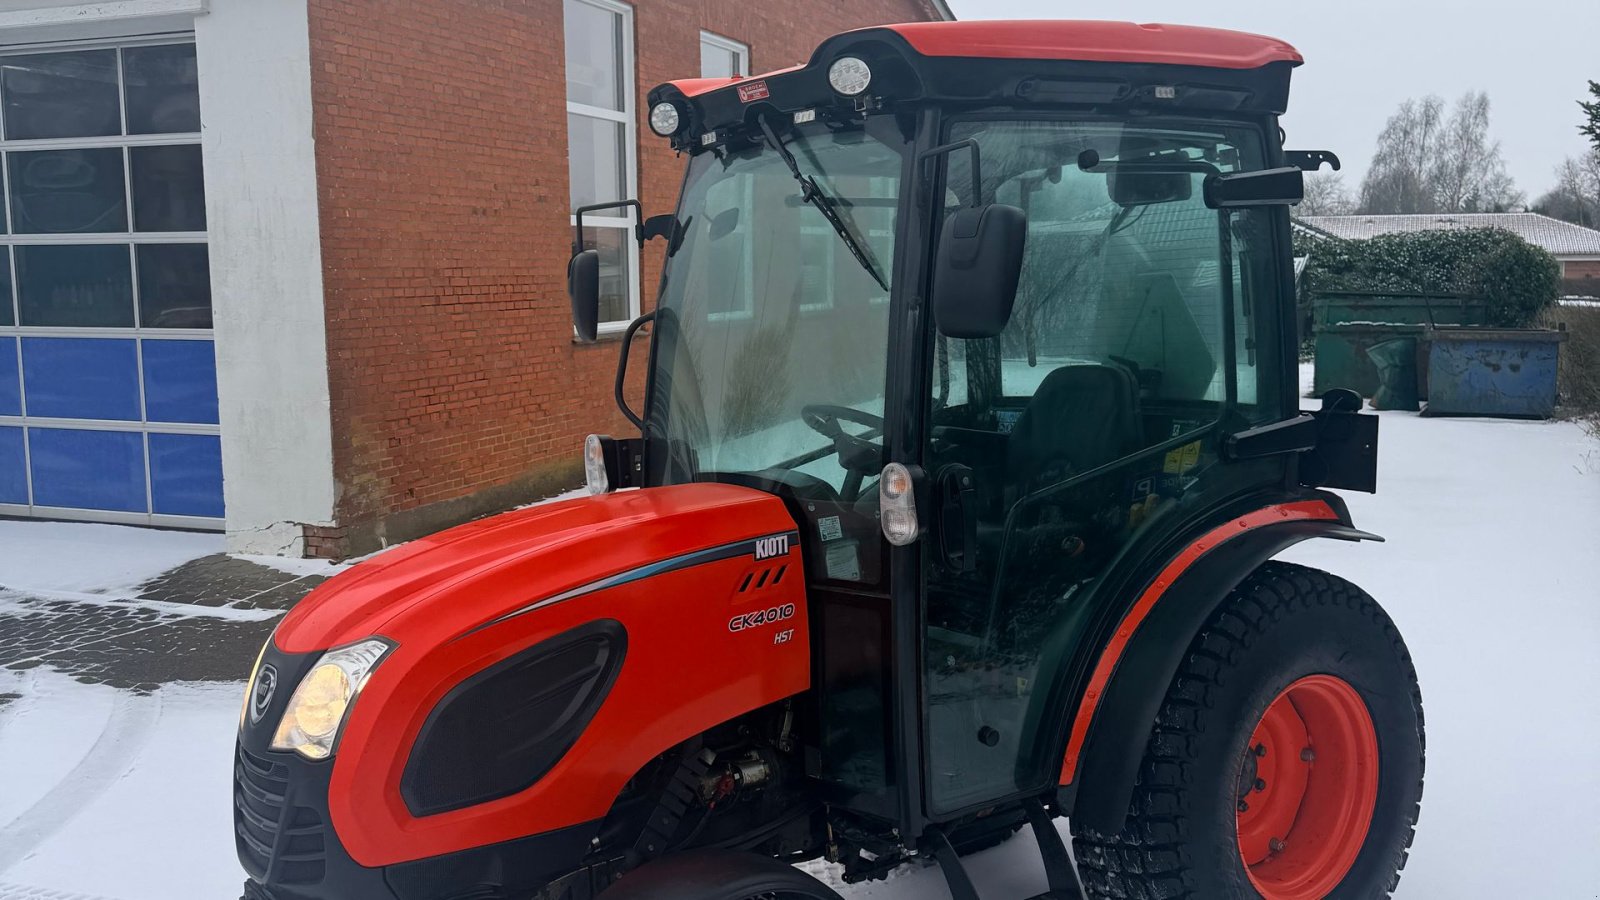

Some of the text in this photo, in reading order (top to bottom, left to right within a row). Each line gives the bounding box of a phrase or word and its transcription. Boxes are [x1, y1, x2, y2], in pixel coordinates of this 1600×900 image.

[756, 535, 788, 559] KIOTI
[729, 603, 795, 632] CK4010
[774, 629, 794, 644] HST
